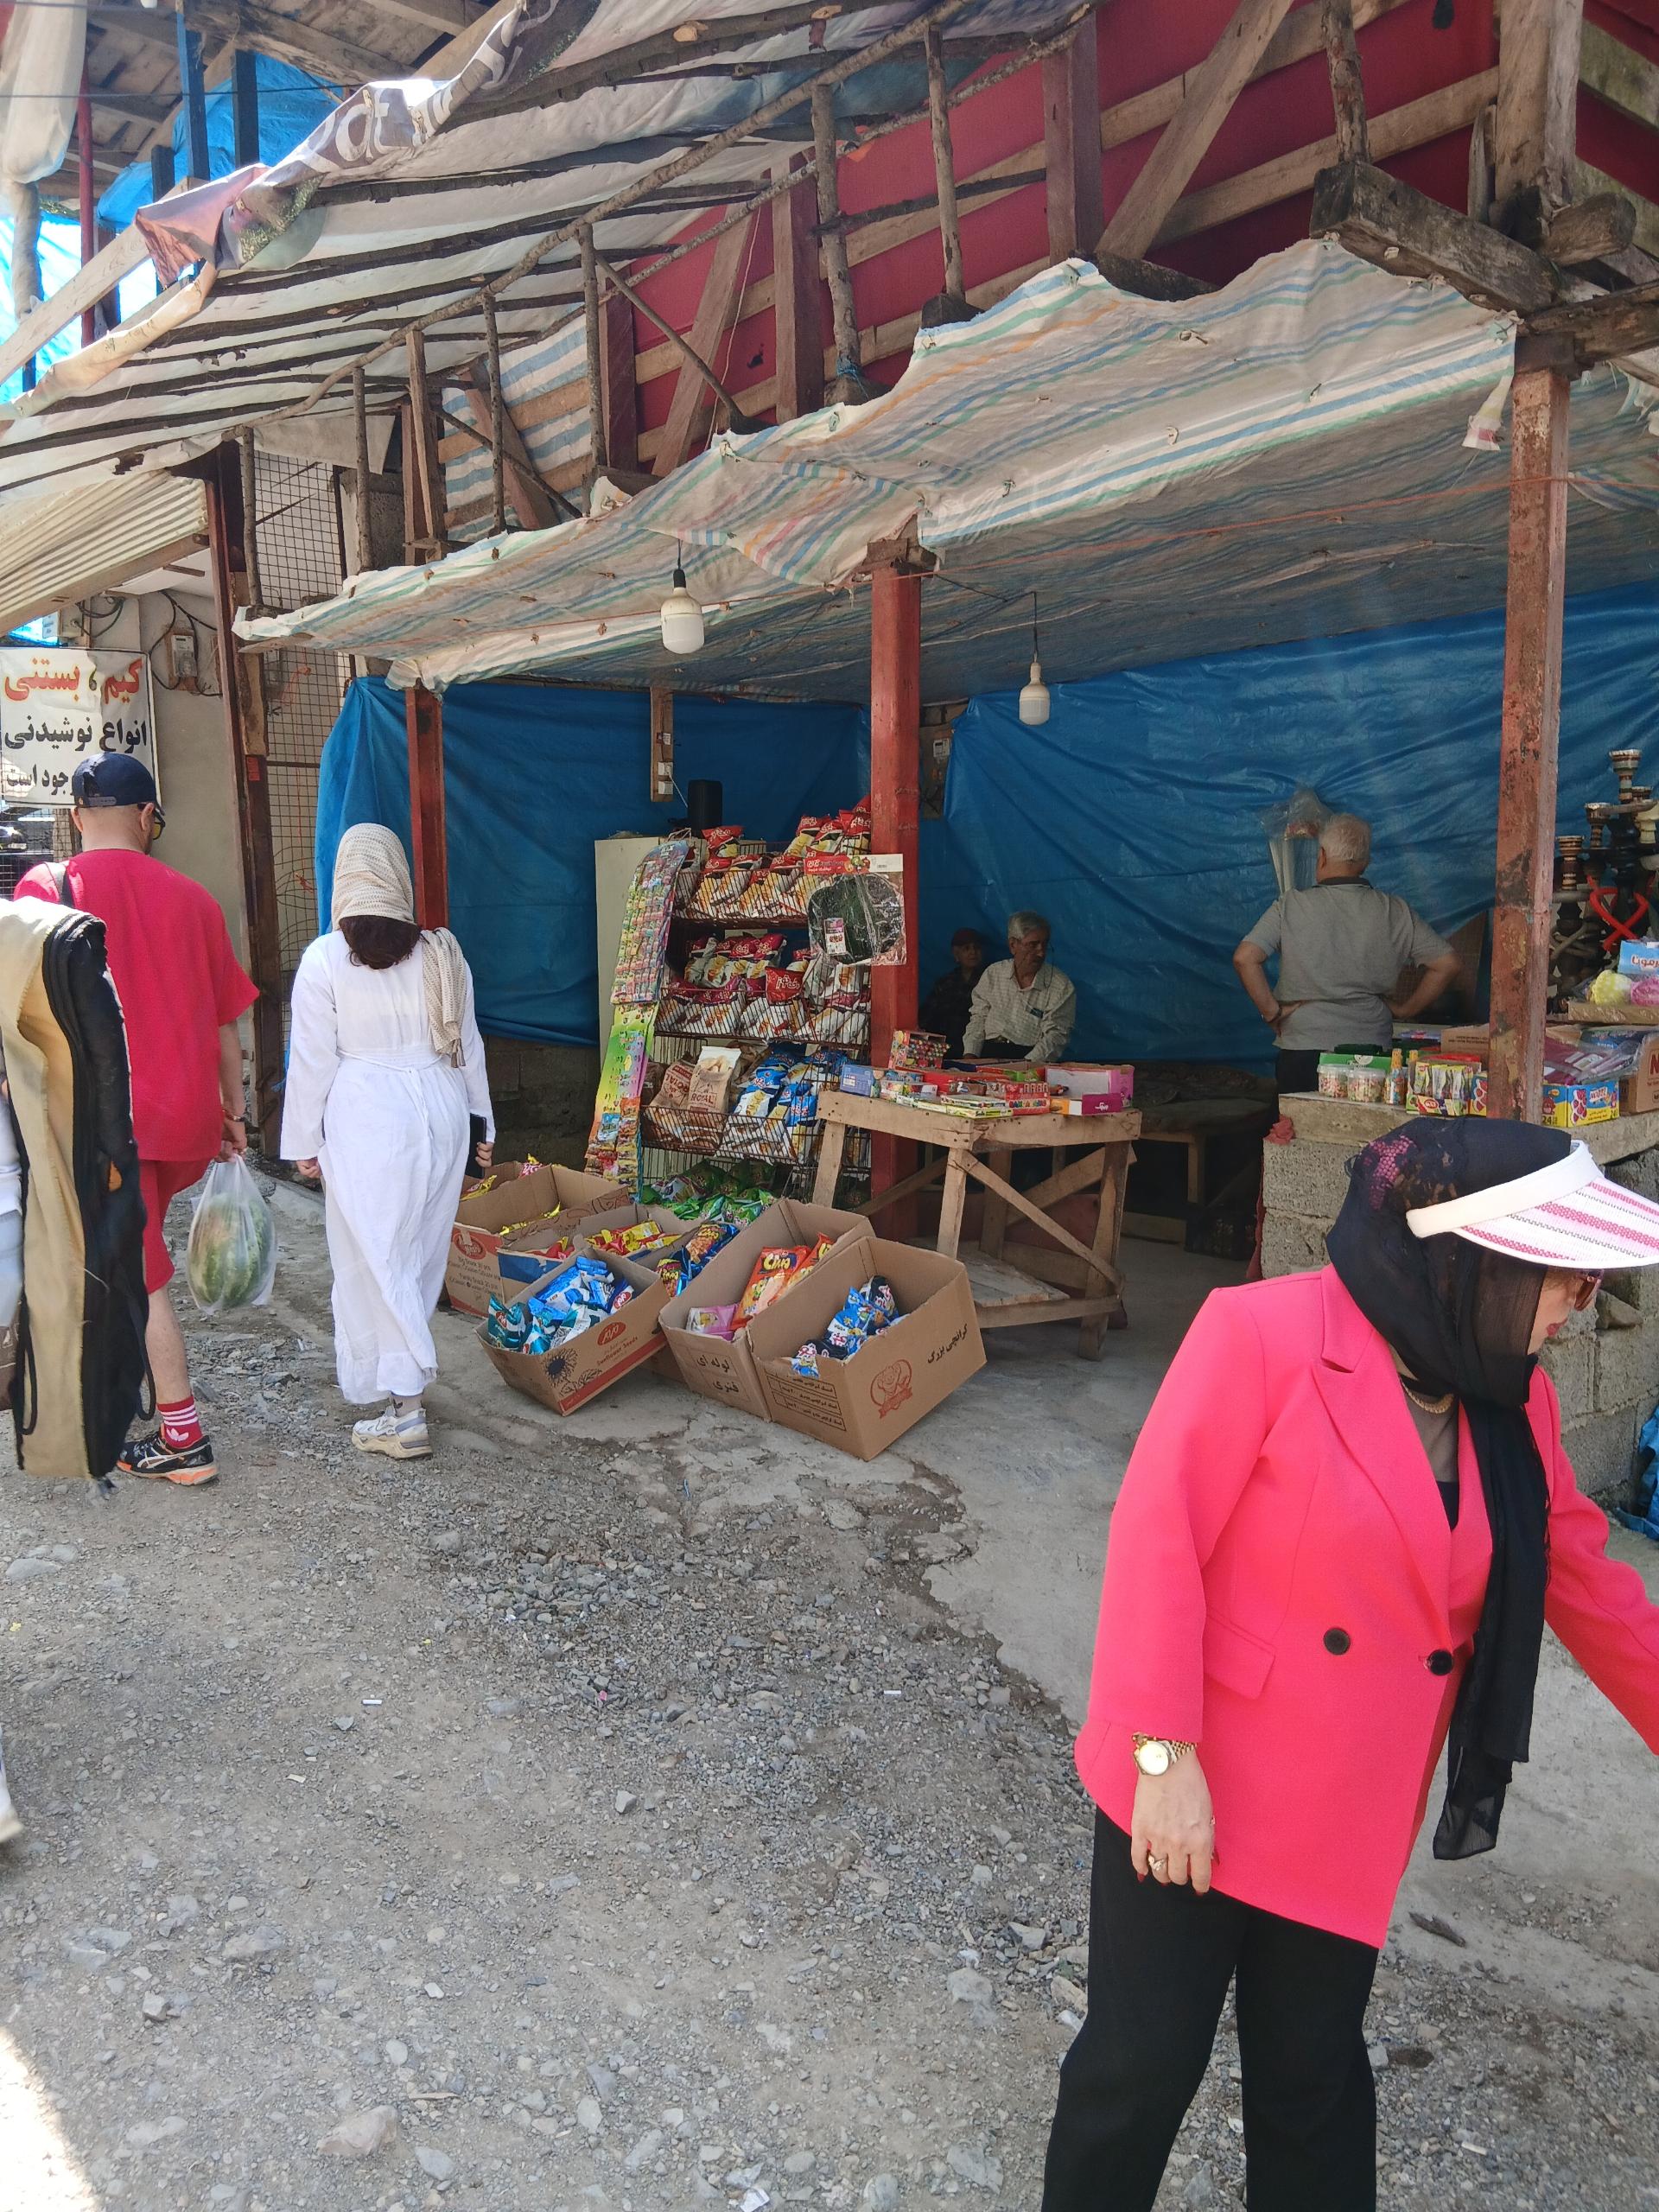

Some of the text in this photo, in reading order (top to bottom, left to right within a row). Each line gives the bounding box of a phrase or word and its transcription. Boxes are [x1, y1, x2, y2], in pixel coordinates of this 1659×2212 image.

[4, 657, 80, 702] بستنی
[105, 658, 143, 705] کیم
[4, 715, 148, 753] انواع نوشیدنی
[6, 764, 75, 796] جود است
